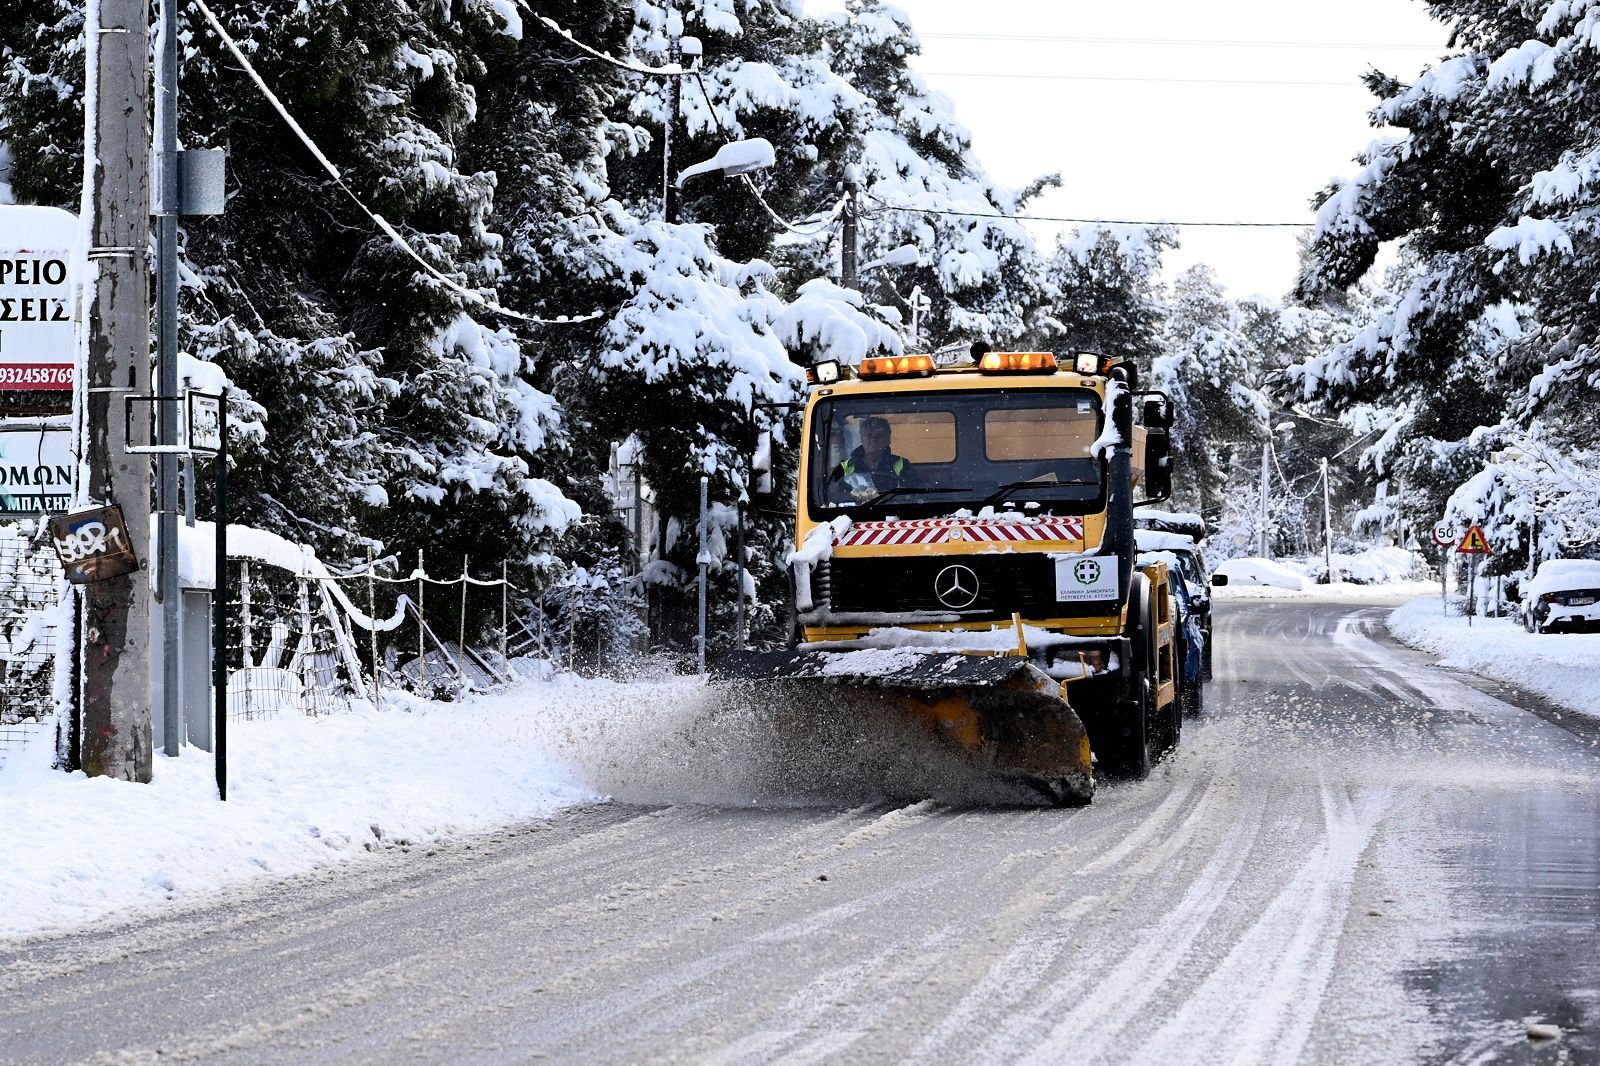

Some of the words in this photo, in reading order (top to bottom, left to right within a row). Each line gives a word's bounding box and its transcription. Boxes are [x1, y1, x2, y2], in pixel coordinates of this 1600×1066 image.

[0, 259, 67, 285] ΡΕΙΟ
[0, 298, 70, 321] ΣΕΙΣ
[1438, 527, 1454, 538] 50
